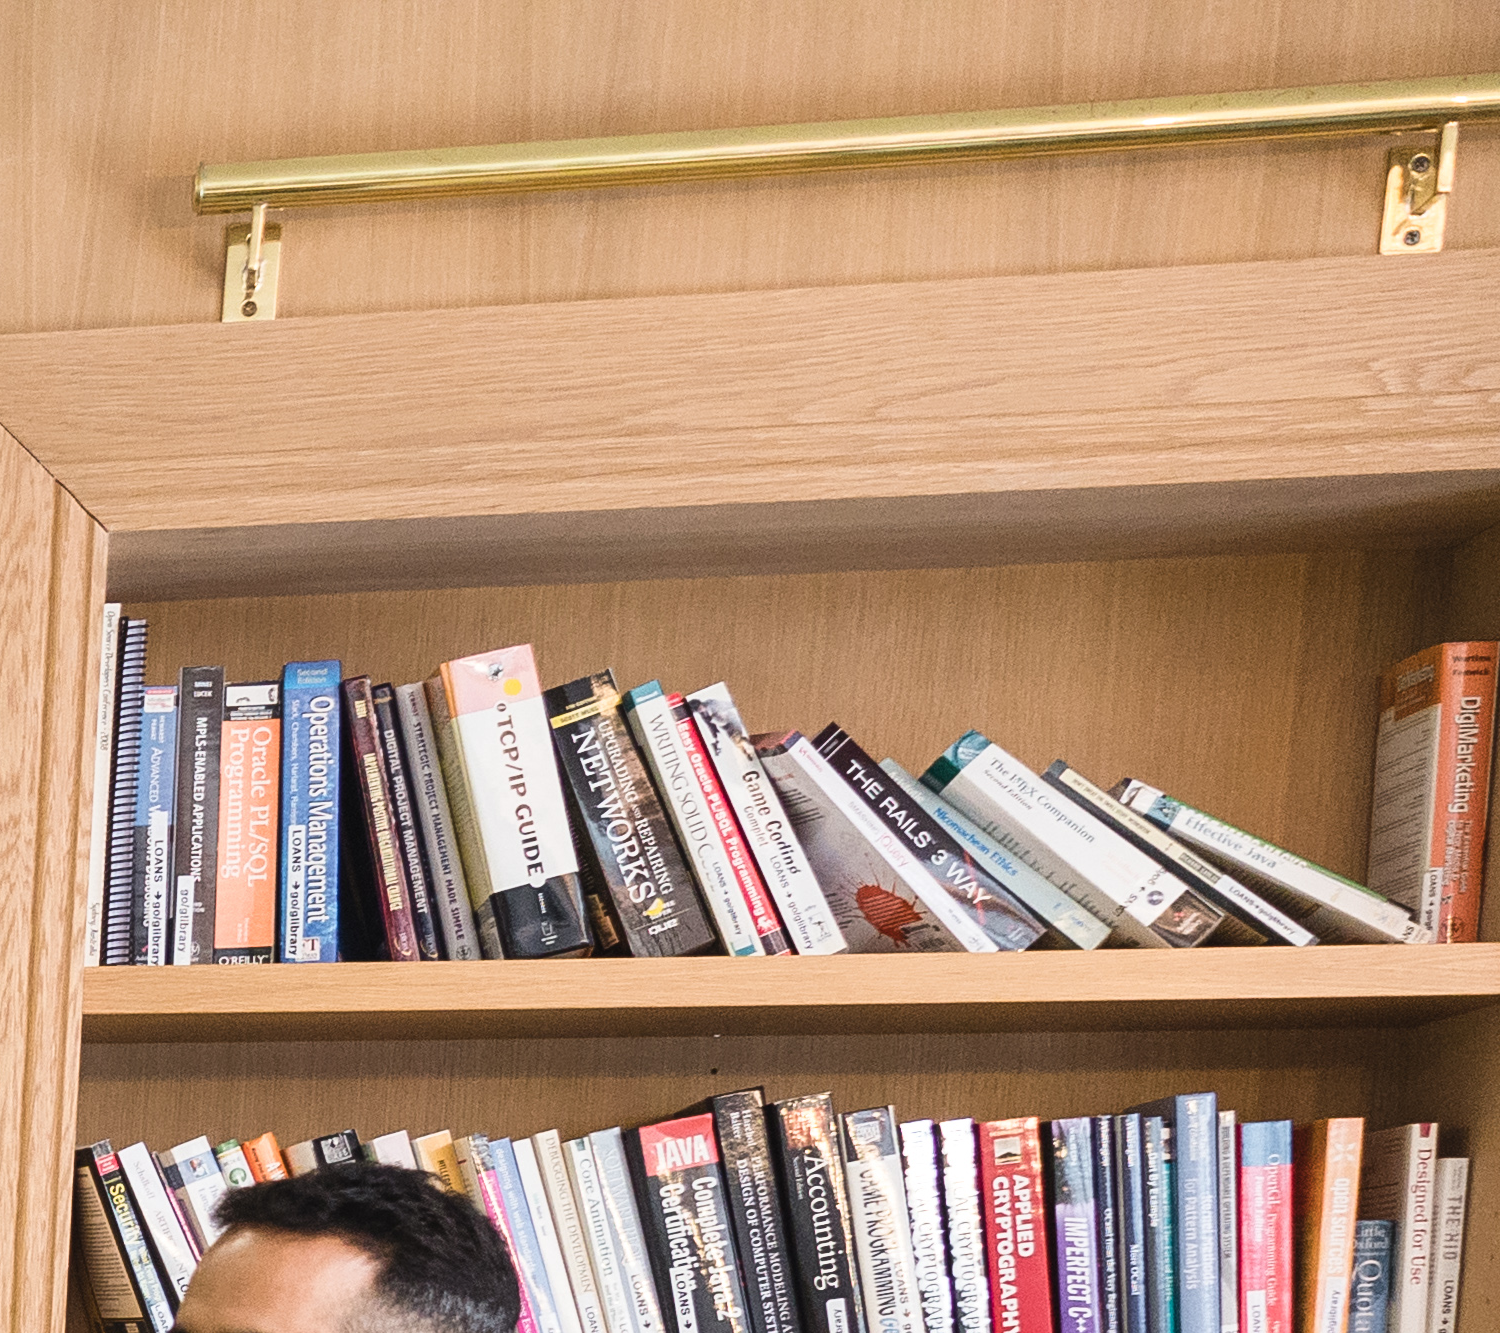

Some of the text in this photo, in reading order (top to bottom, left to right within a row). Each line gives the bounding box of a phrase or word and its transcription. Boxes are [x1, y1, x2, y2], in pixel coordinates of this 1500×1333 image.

[194, 717, 208, 805] MPLS-ENABLED
[222, 727, 250, 879] Programming
[249, 727, 272, 797] Oracle
[307, 695, 334, 923] Operations Management
[496, 714, 544, 877] TCP/IP GUIDE
[599, 720, 674, 896] UPGRADING REPAIRING
[649, 713, 708, 840] WRITING SOLID
[742, 770, 771, 817] Game
[1448, 695, 1482, 814] DigiMarketing
[248, 805, 270, 887] PL/SQL
[384, 729, 427, 914] DIGITAL PROJECT MANAGEMENT
[413, 722, 464, 941] STRATEGIC PROJECT MANAGEMENT MADE SIMPLE
[571, 727, 657, 903] NETWORKS
[678, 723, 767, 918] Easy Oracle PL/SQL Programming
[846, 759, 879, 795] THE
[879, 795, 934, 849] RAILS
[931, 850, 949, 866] 3
[946, 864, 993, 905] WAY
[934, 806, 1019, 876] Nicomachean Ethics
[1035, 794, 1096, 844] Companion
[1185, 816, 1244, 851] Effective
[1245, 848, 1277, 870] Java
[655, 1134, 710, 1172] JAVA
[736, 1157, 756, 1206] DESIGN
[108, 1182, 144, 1244] Security
[580, 1158, 613, 1277] Core Animation
[744, 1208, 759, 1225] OF
[749, 1227, 771, 1300] COMPUTER
[750, 1155, 780, 1251] PERFORMANCE
[769, 1252, 791, 1321] MODELING
[804, 1155, 840, 1290] Accounting
[865, 1211, 894, 1316] PROGRAMMING
[1013, 1174, 1035, 1257] APPLIED
[1411, 1148, 1432, 1286] Designed for Use
[1063, 1216, 1092, 1333] IMPERFECT C++
